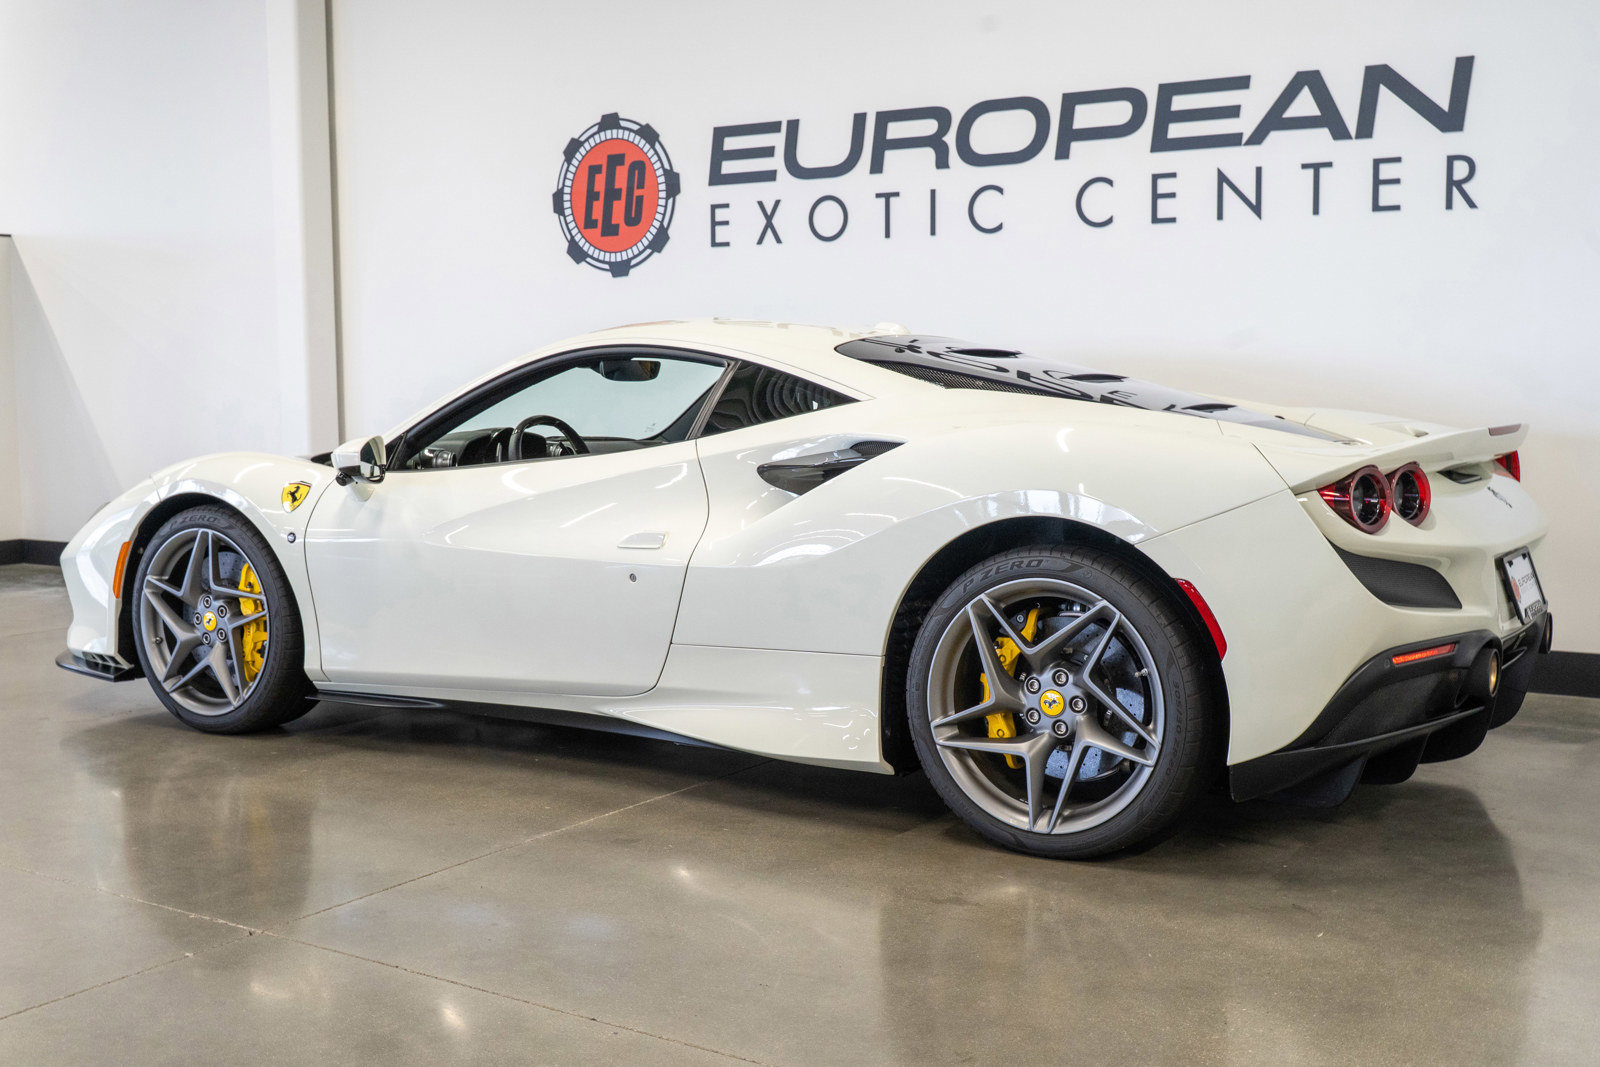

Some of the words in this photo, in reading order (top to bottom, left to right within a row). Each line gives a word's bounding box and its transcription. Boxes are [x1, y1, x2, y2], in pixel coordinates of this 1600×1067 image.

[708, 55, 1475, 187] EUROPEAN
[583, 152, 647, 238] EEC
[710, 184, 1005, 248] EXOTIC
[1075, 154, 1478, 229] CENTER
[962, 577, 975, 594] P
[981, 559, 1044, 580] ZERO
